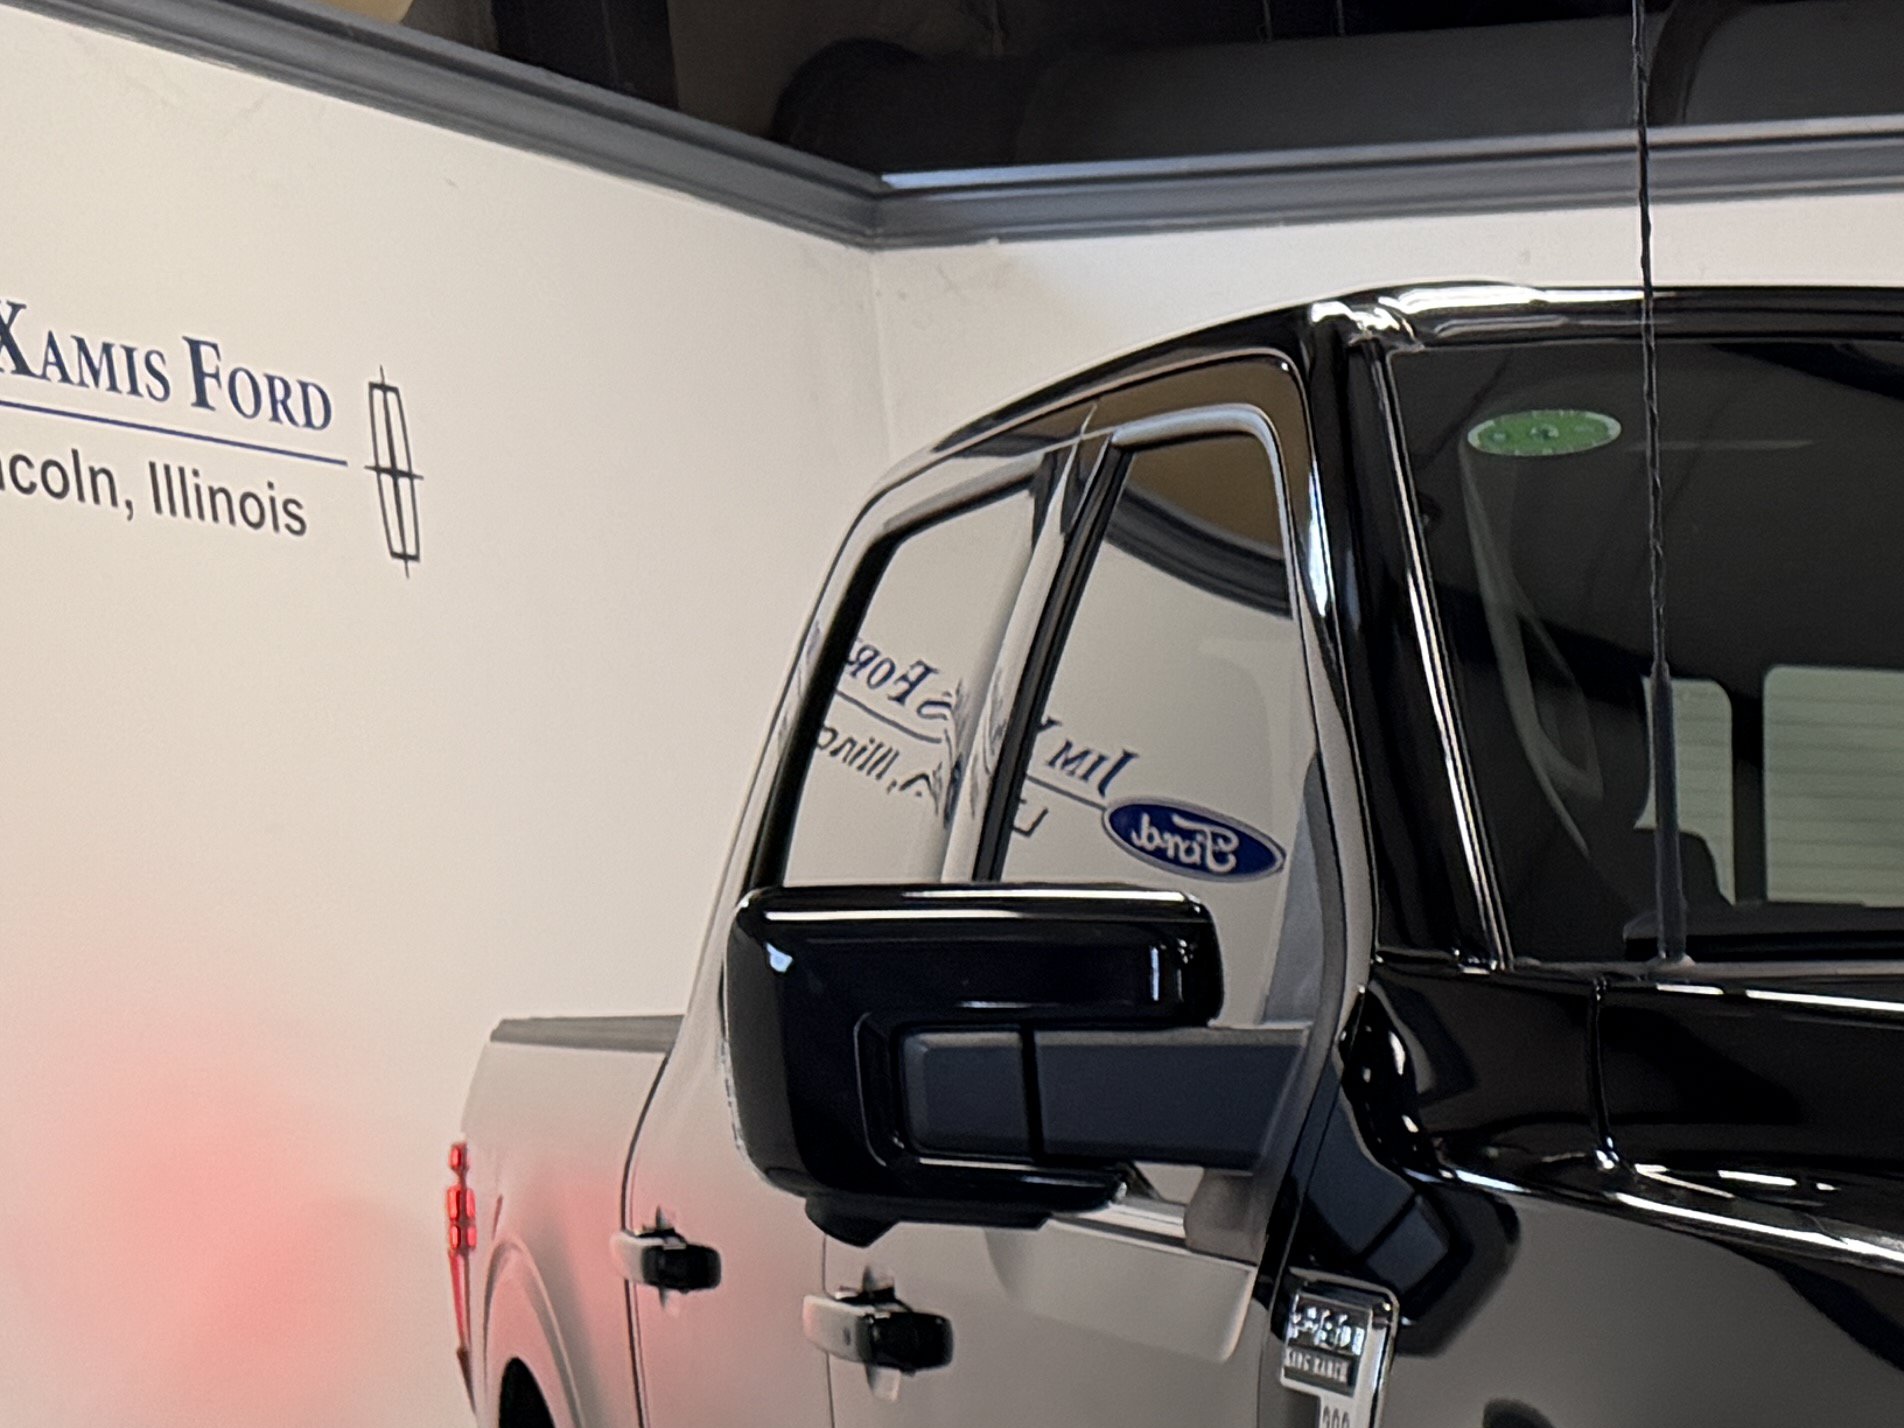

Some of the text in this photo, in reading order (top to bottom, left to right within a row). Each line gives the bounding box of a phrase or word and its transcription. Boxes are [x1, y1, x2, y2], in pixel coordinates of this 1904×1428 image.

[182, 336, 333, 431] FORD
[0, 447, 308, 537] coln, Illinois
